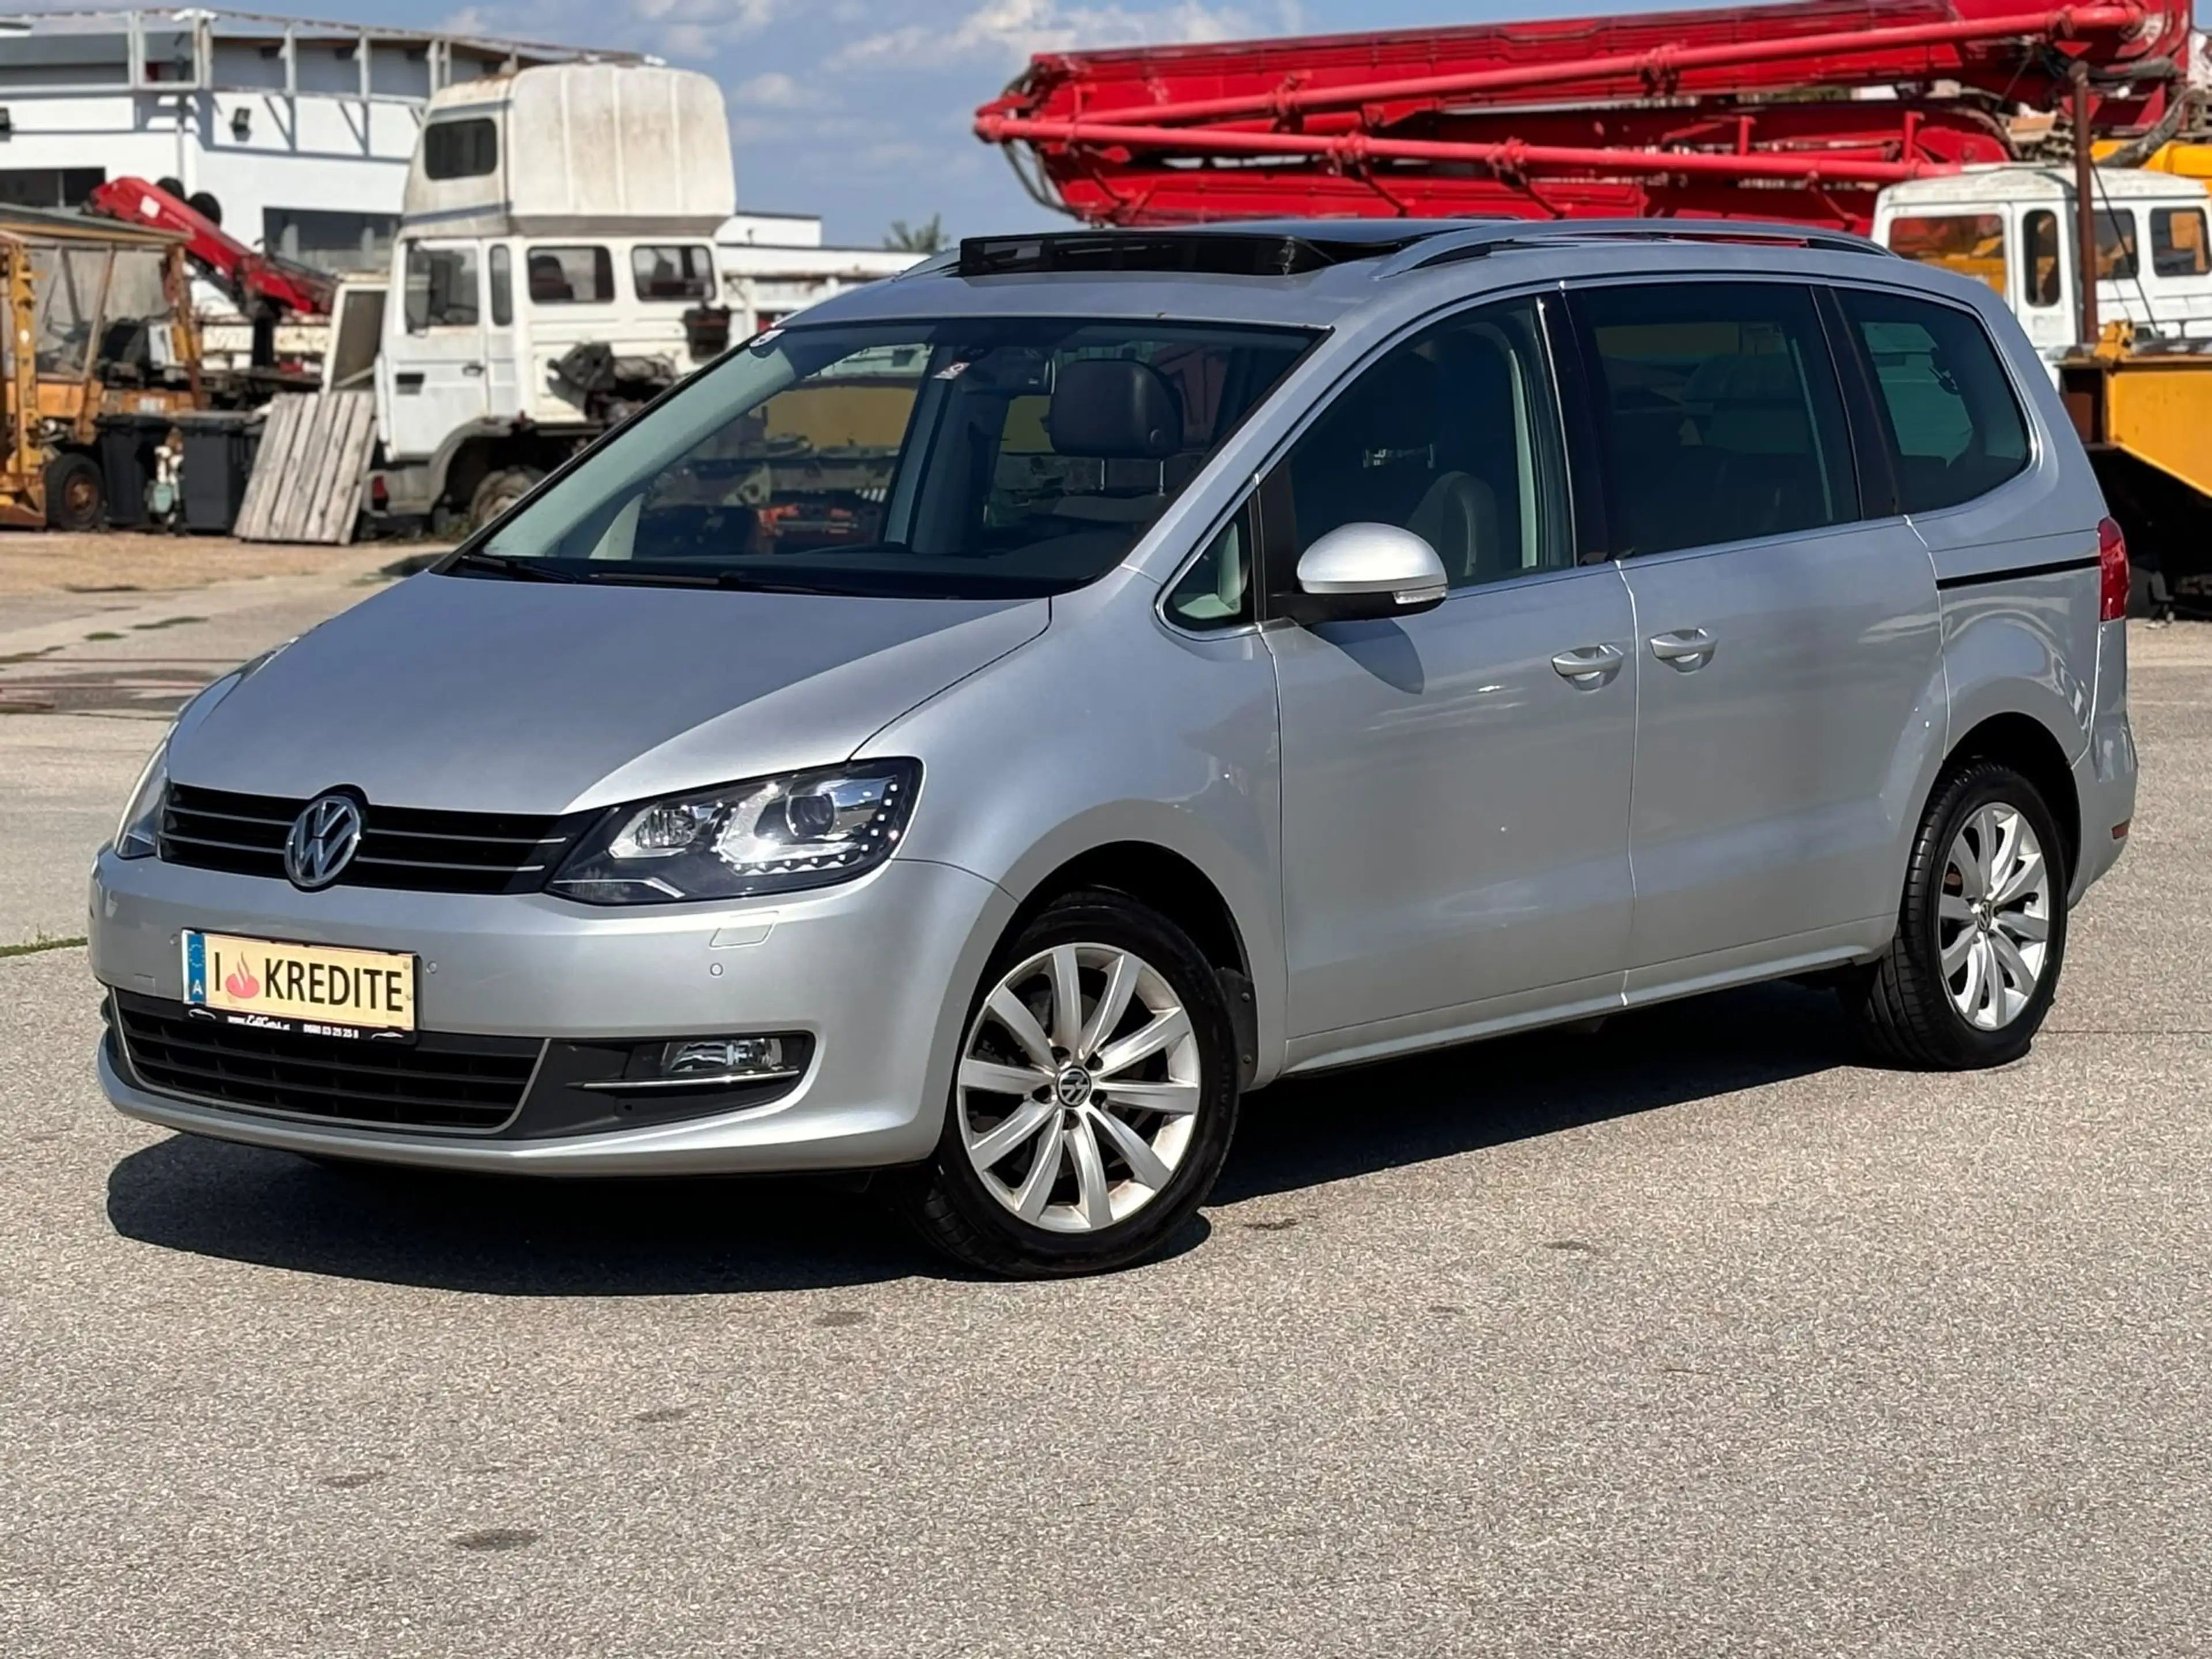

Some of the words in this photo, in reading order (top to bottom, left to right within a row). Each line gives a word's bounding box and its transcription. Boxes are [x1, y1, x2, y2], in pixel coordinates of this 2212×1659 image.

[285, 796, 361, 887] VW
[192, 979, 203, 995] A
[215, 952, 220, 991] I
[265, 958, 403, 1012] KREDITE
[1059, 1068, 1089, 1105] VW
